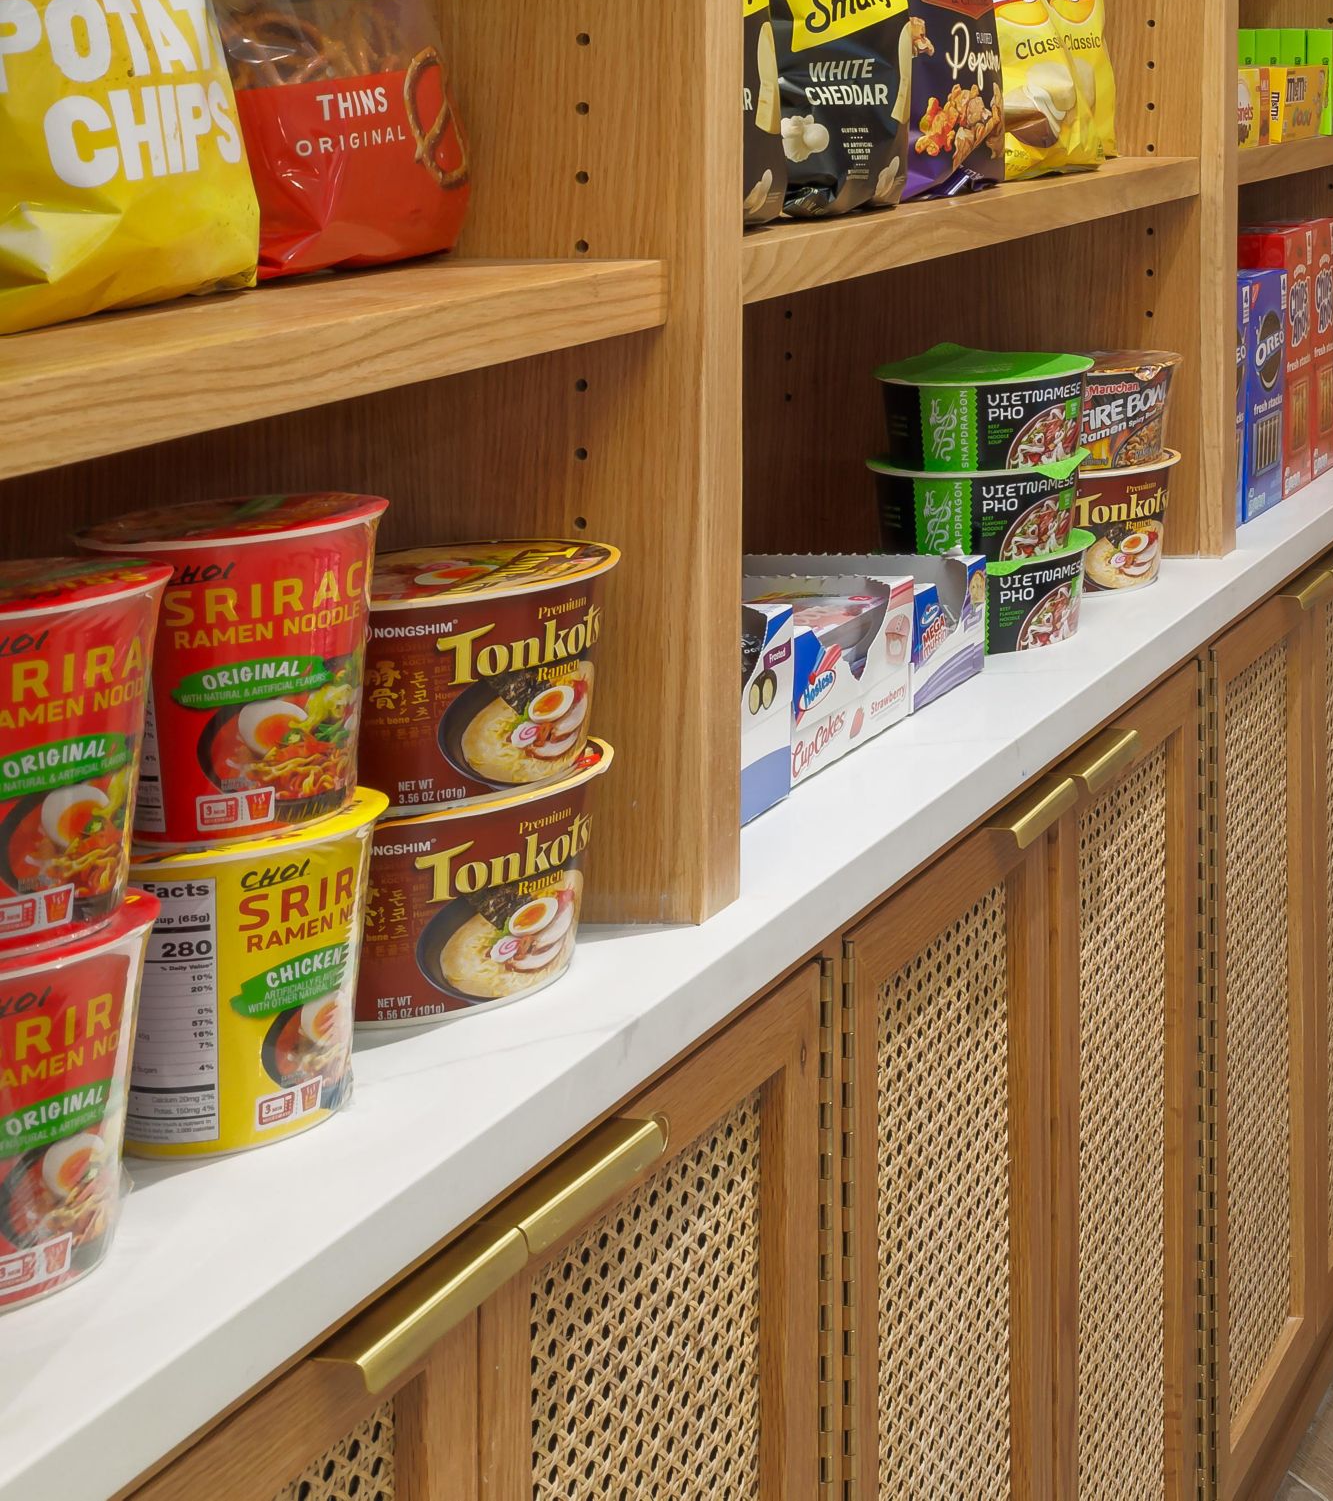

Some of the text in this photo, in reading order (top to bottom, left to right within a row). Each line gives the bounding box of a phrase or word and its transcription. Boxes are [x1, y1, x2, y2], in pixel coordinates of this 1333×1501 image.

[1063, 32, 1101, 51] Classic
[808, 58, 876, 83] WHITE
[315, 86, 390, 123] THINS
[804, 83, 889, 107] CHEDDAR
[43, 82, 242, 190] CHIPS
[295, 127, 407, 158] ORIGINAL
[1255, 328, 1286, 368] OREO
[987, 380, 1082, 406] VIETNAMESE
[1089, 381, 1139, 396] Maruchan
[987, 405, 1025, 422] PHO
[1253, 393, 1284, 417] fresh stacks
[960, 389, 969, 469] SNAPDRAGON
[1079, 420, 1127, 446] Ramen
[999, 560, 1084, 590] VIETNAMESE
[537, 595, 588, 620] Premium
[1000, 587, 1035, 604] PHO
[174, 620, 274, 650] RAMEN
[373, 621, 454, 640] NONGSHIM
[921, 612, 946, 644] MEGA
[201, 659, 301, 691] ORIGINAL
[536, 657, 581, 683] Ramen
[803, 671, 834, 710] Hostess
[870, 683, 907, 716] Strawberry
[791, 707, 848, 780] CupCakes
[2, 738, 107, 780] ORIGINAL
[398, 778, 434, 793] NET WT
[418, 790, 435, 803] OZ
[436, 785, 467, 802] (101g)
[518, 806, 573, 834] Premium
[240, 858, 311, 893] CHOI
[178, 912, 211, 925] (65g)
[246, 911, 335, 954] RAMEN
[161, 939, 213, 959] 280
[191, 973, 213, 982] 10%
[265, 946, 343, 989] CHICKEN
